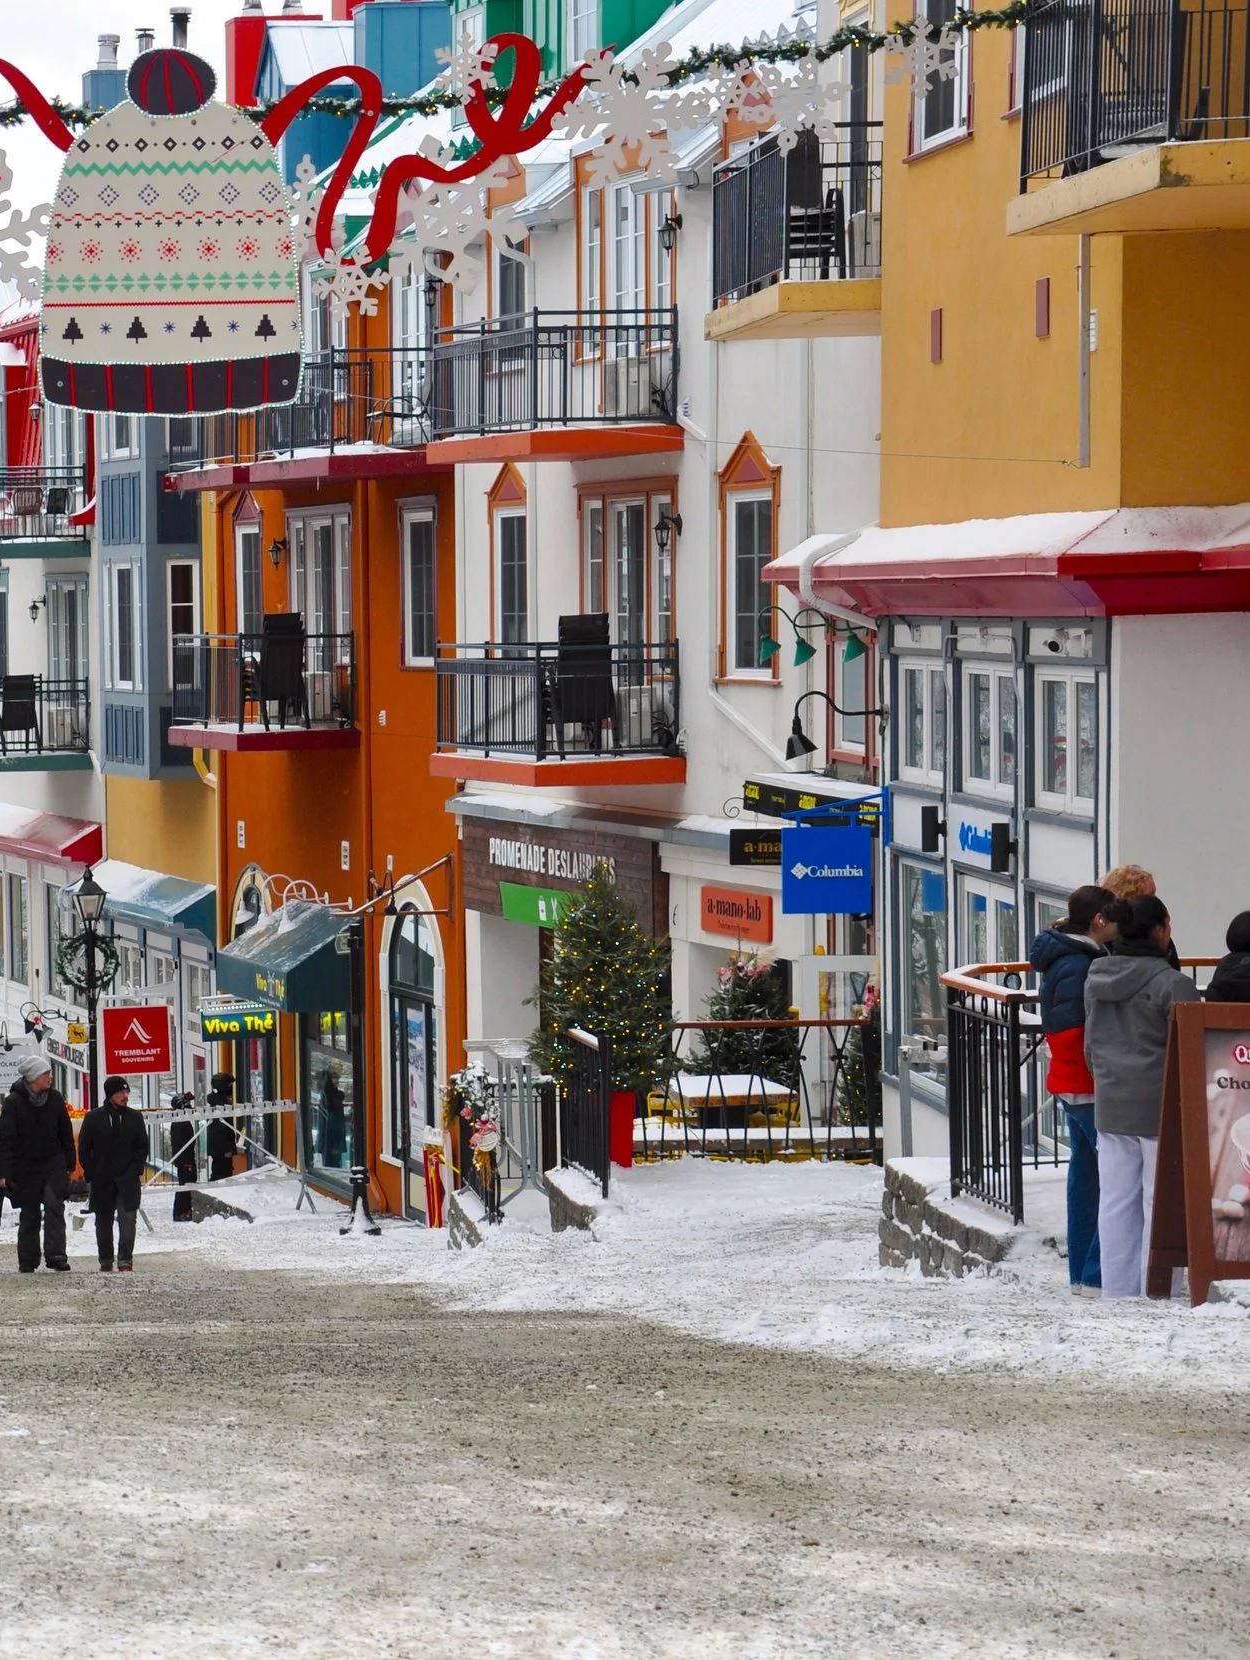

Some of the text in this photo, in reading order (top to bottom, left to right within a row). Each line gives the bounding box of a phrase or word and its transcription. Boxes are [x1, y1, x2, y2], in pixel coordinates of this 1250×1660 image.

[489, 837, 546, 874] PROMENADE
[806, 864, 864, 878] Columbia
[204, 1012, 274, 1034] Viva Thé
[114, 1048, 162, 1057] TREMBLANT
[121, 1056, 155, 1064] SOUVENIRS
